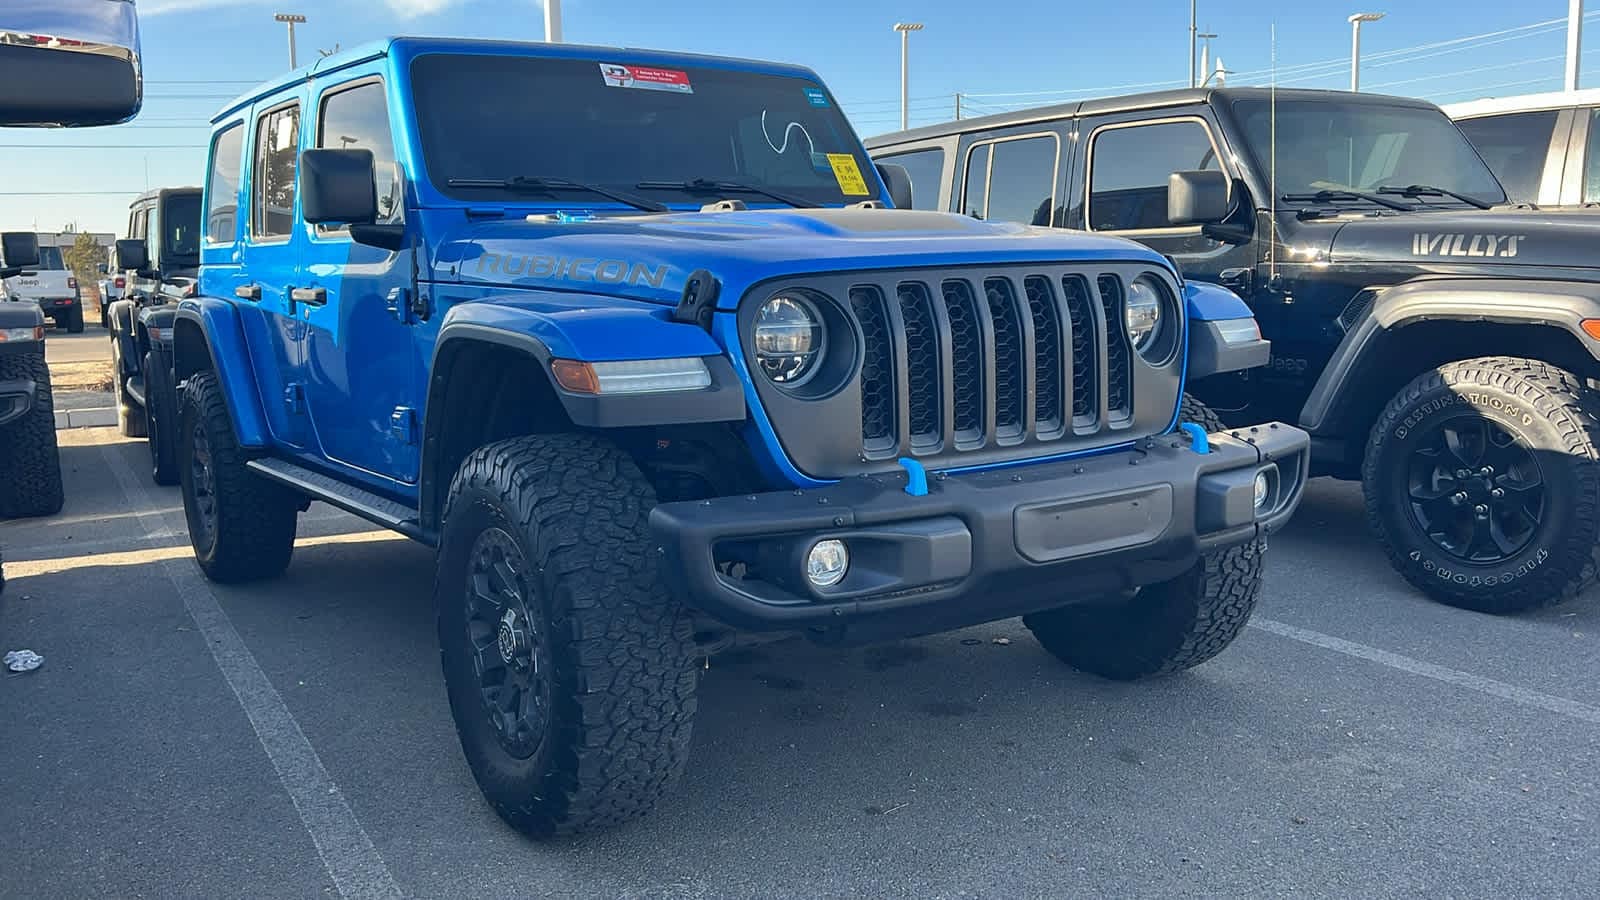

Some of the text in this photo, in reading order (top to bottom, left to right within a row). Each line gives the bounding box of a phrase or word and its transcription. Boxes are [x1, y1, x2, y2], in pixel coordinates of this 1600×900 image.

[1412, 233, 1526, 257] WILLYS
[17, 278, 40, 288] Jeep
[475, 252, 669, 288] RUBICON
[1394, 392, 1519, 440] DESTINATION
